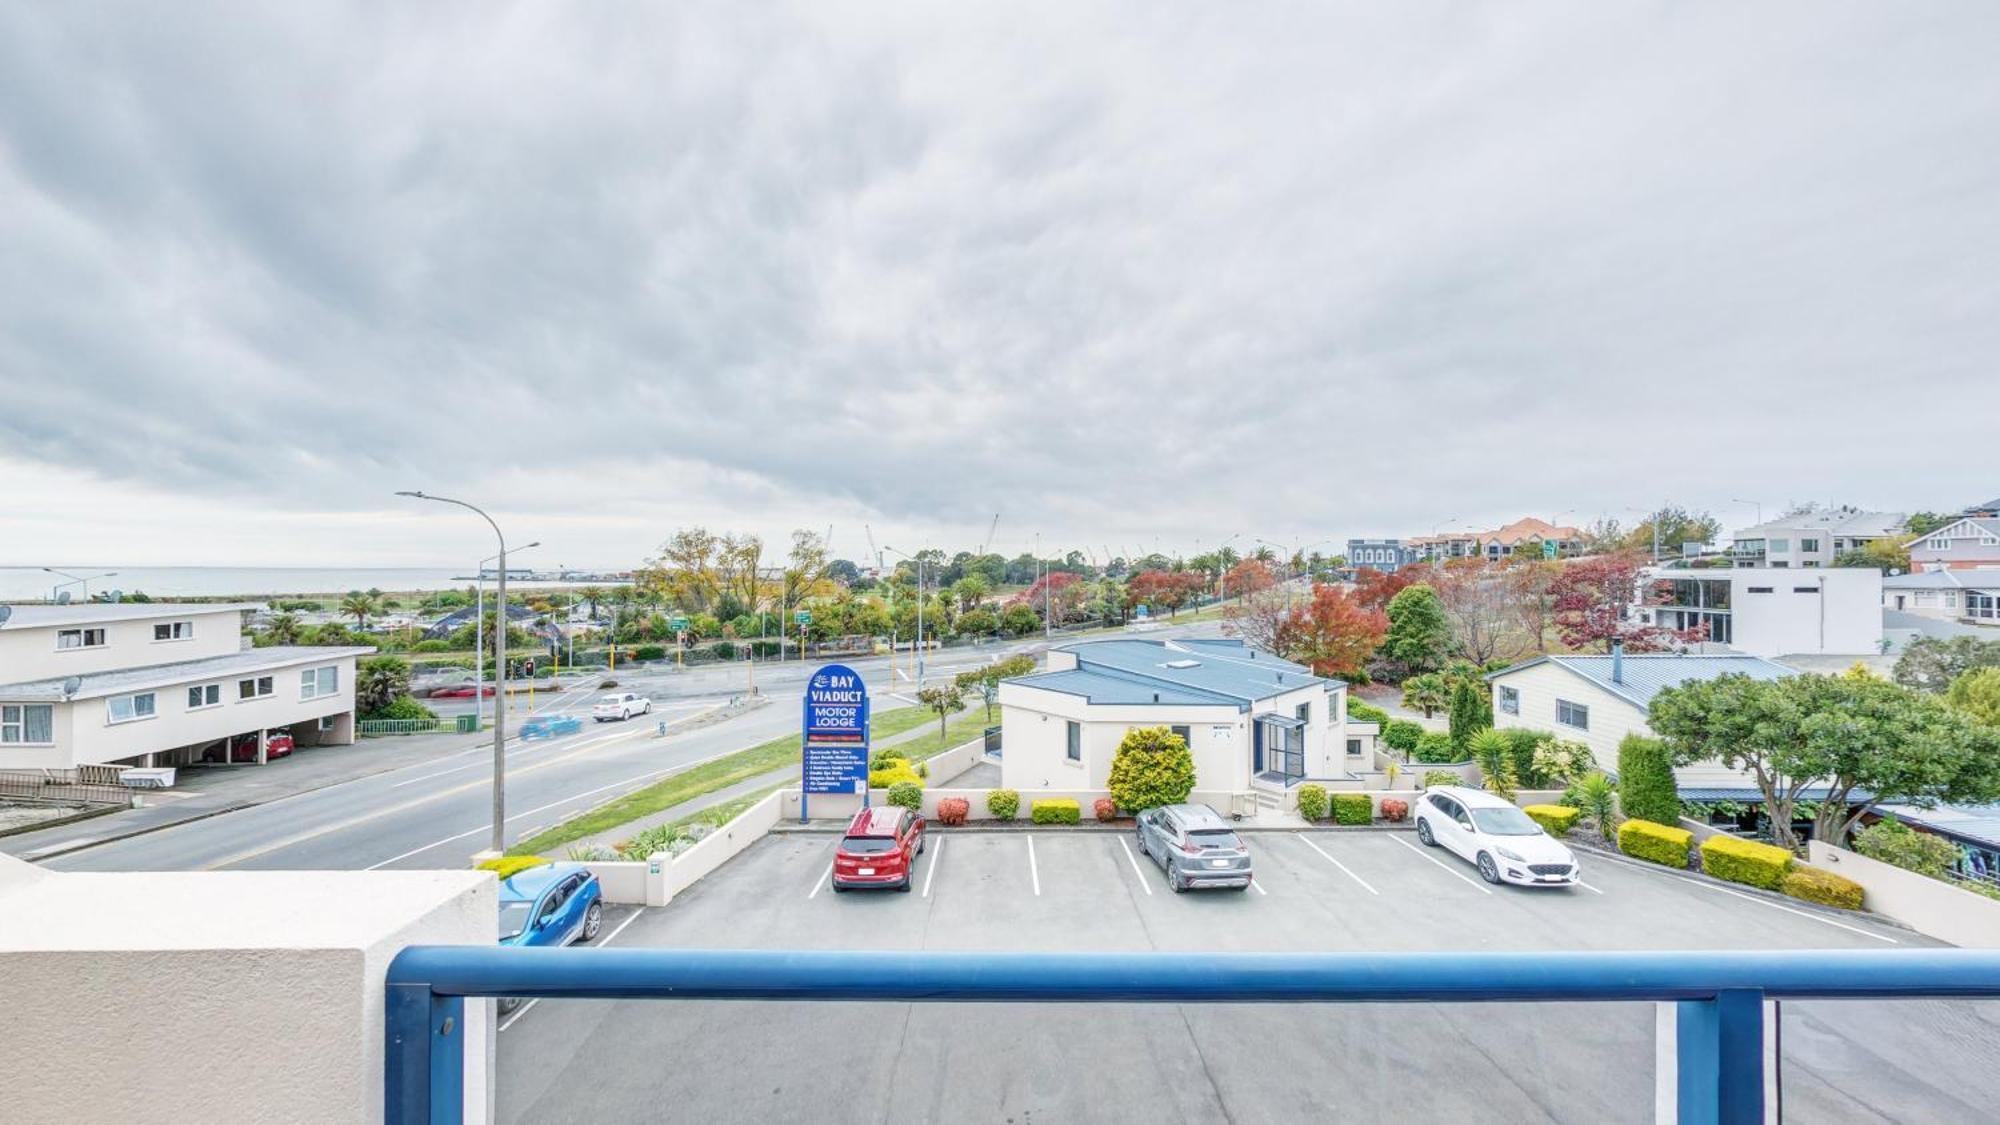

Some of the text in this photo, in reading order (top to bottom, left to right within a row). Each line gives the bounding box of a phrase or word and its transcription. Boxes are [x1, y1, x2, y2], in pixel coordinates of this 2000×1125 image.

[831, 676, 854, 688] BAY
[811, 691, 862, 702] VIADUCT
[815, 707, 856, 717] MOTOR
[815, 717, 856, 727] LODGE
